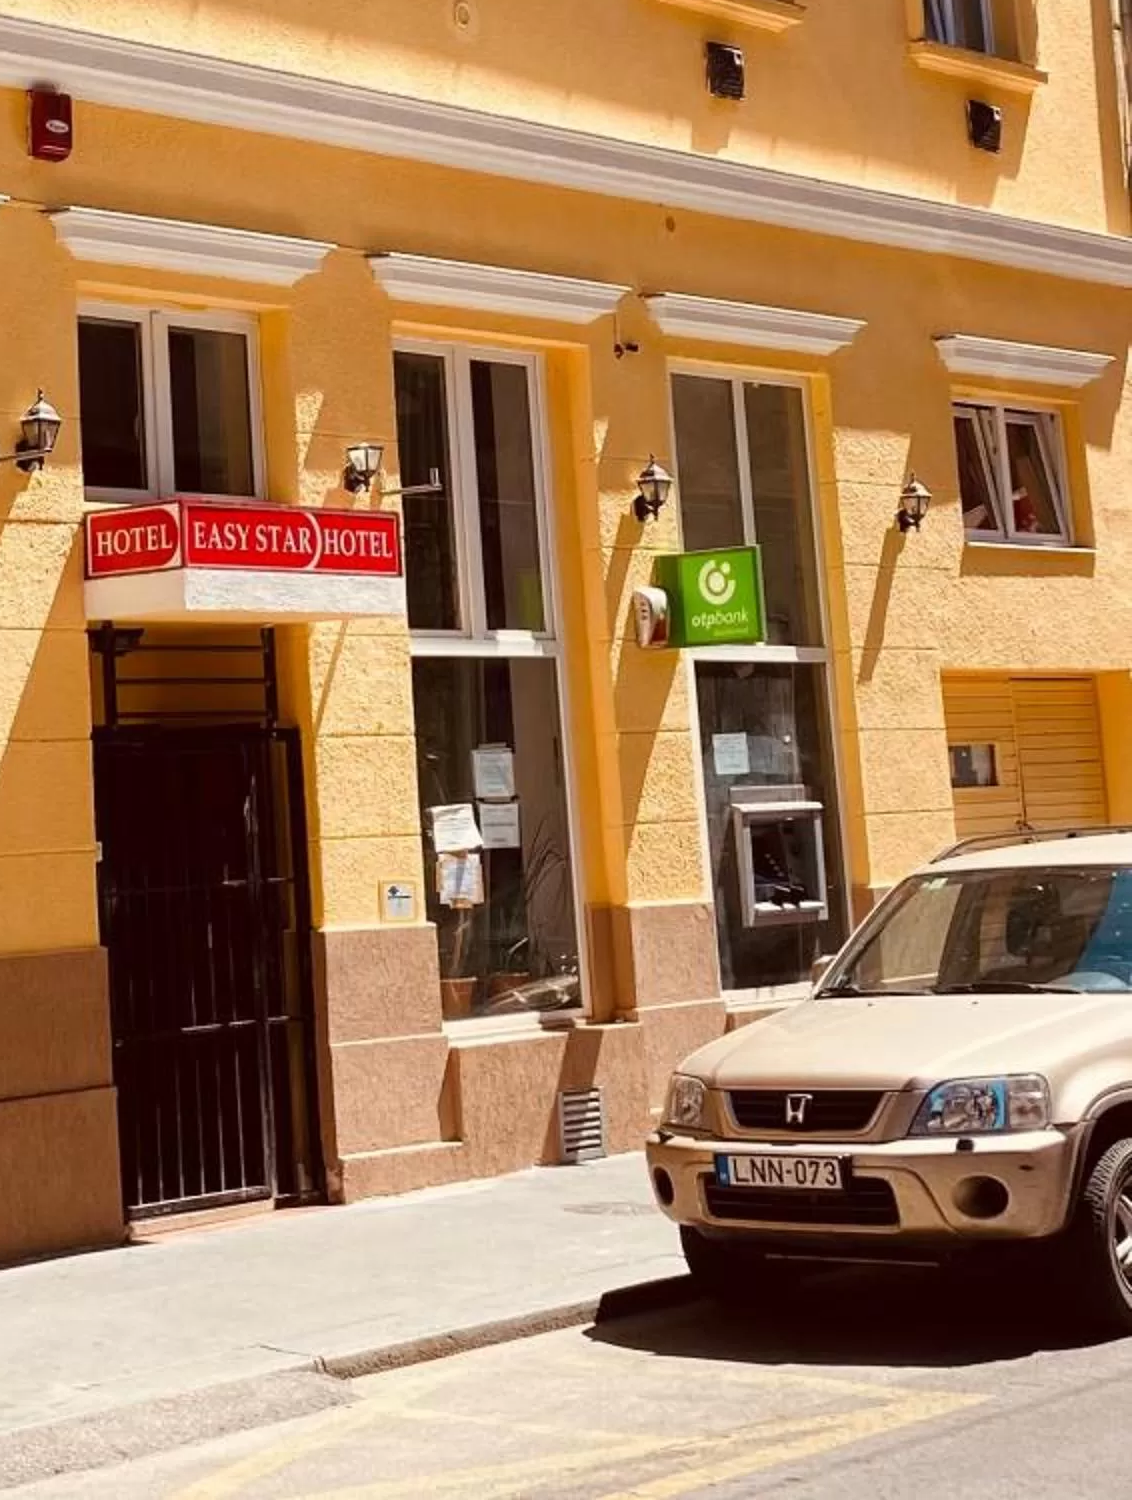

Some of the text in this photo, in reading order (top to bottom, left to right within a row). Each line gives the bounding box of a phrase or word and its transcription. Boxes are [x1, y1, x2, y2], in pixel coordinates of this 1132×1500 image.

[96, 523, 173, 557] HOTEL
[193, 521, 393, 558] EASY STAR HOTEL
[691, 606, 749, 630] otpbank
[733, 1157, 837, 1186] LNN-073
